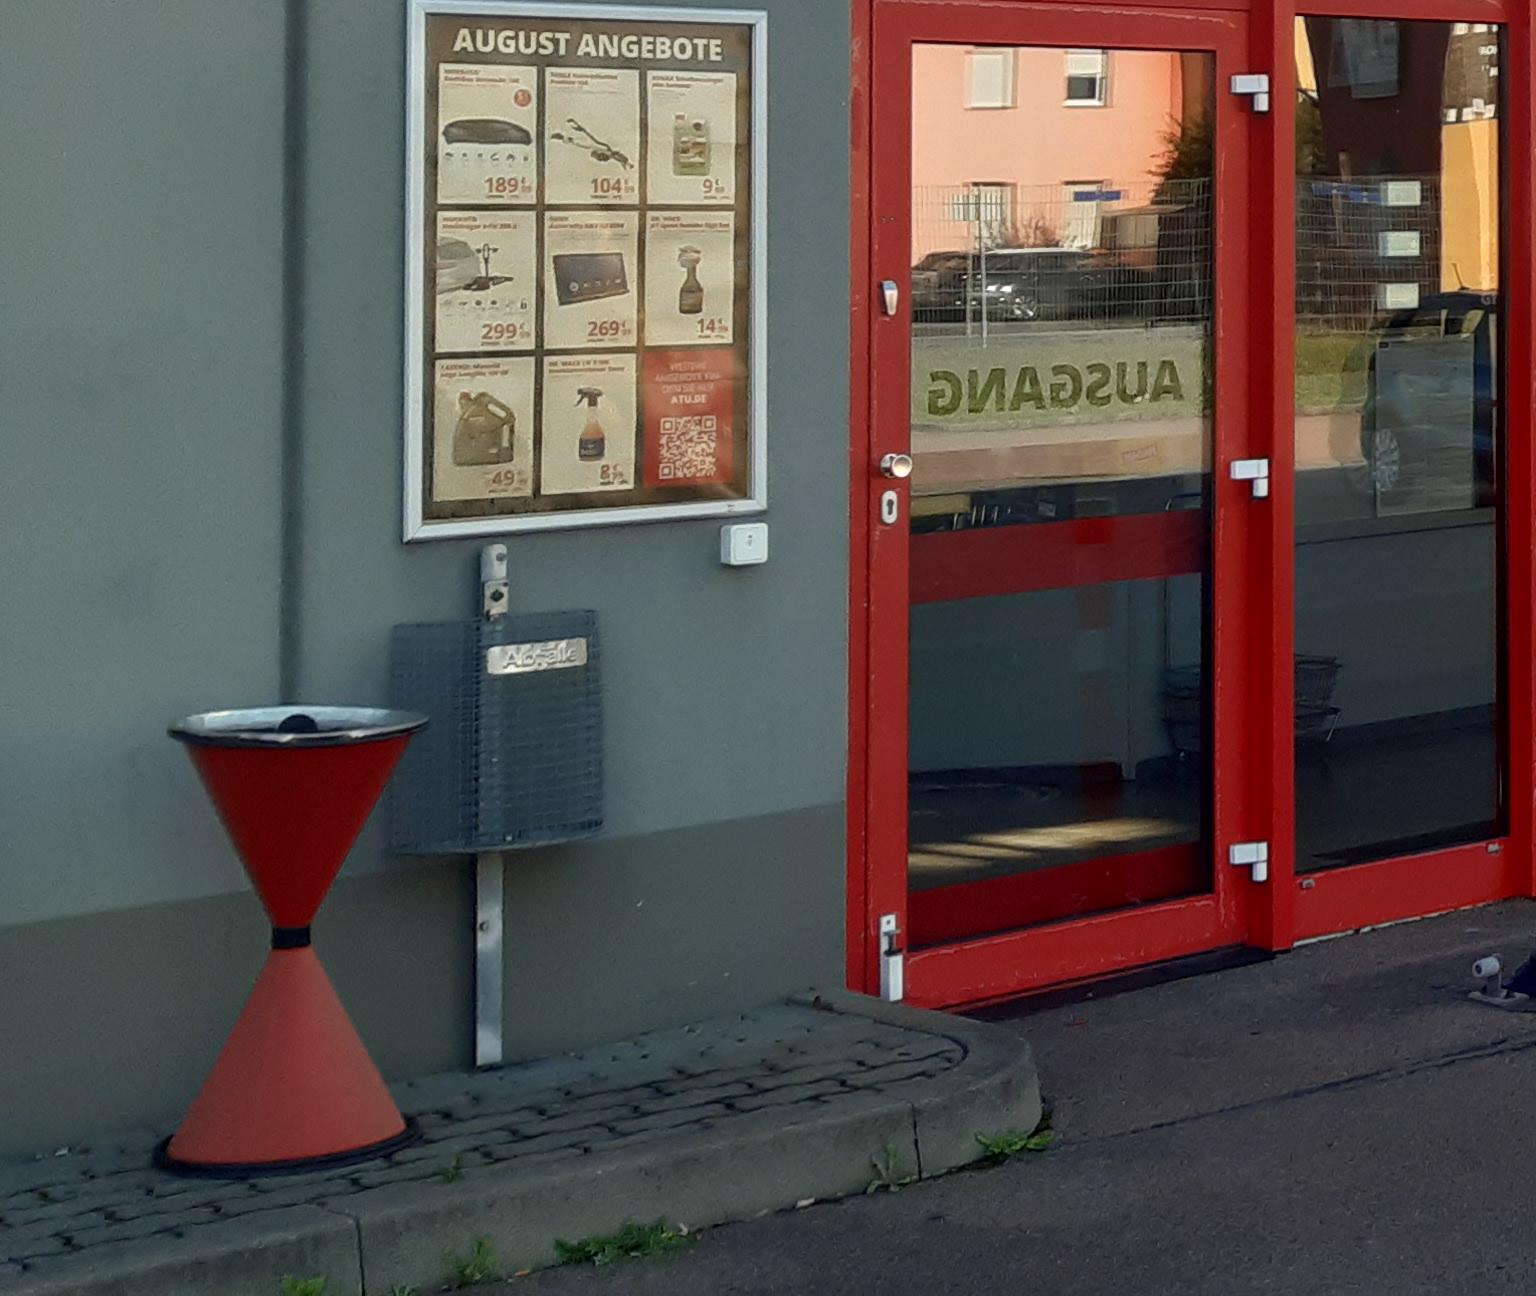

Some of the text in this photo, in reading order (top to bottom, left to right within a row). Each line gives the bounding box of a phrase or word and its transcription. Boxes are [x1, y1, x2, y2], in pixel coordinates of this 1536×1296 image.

[452, 27, 723, 61] AUGUST ANGEBOTE
[484, 176, 519, 193] 189
[590, 177, 622, 194] 104
[481, 323, 518, 340] 299
[587, 320, 620, 337] 269
[697, 318, 716, 334] 14
[491, 470, 515, 486] 49
